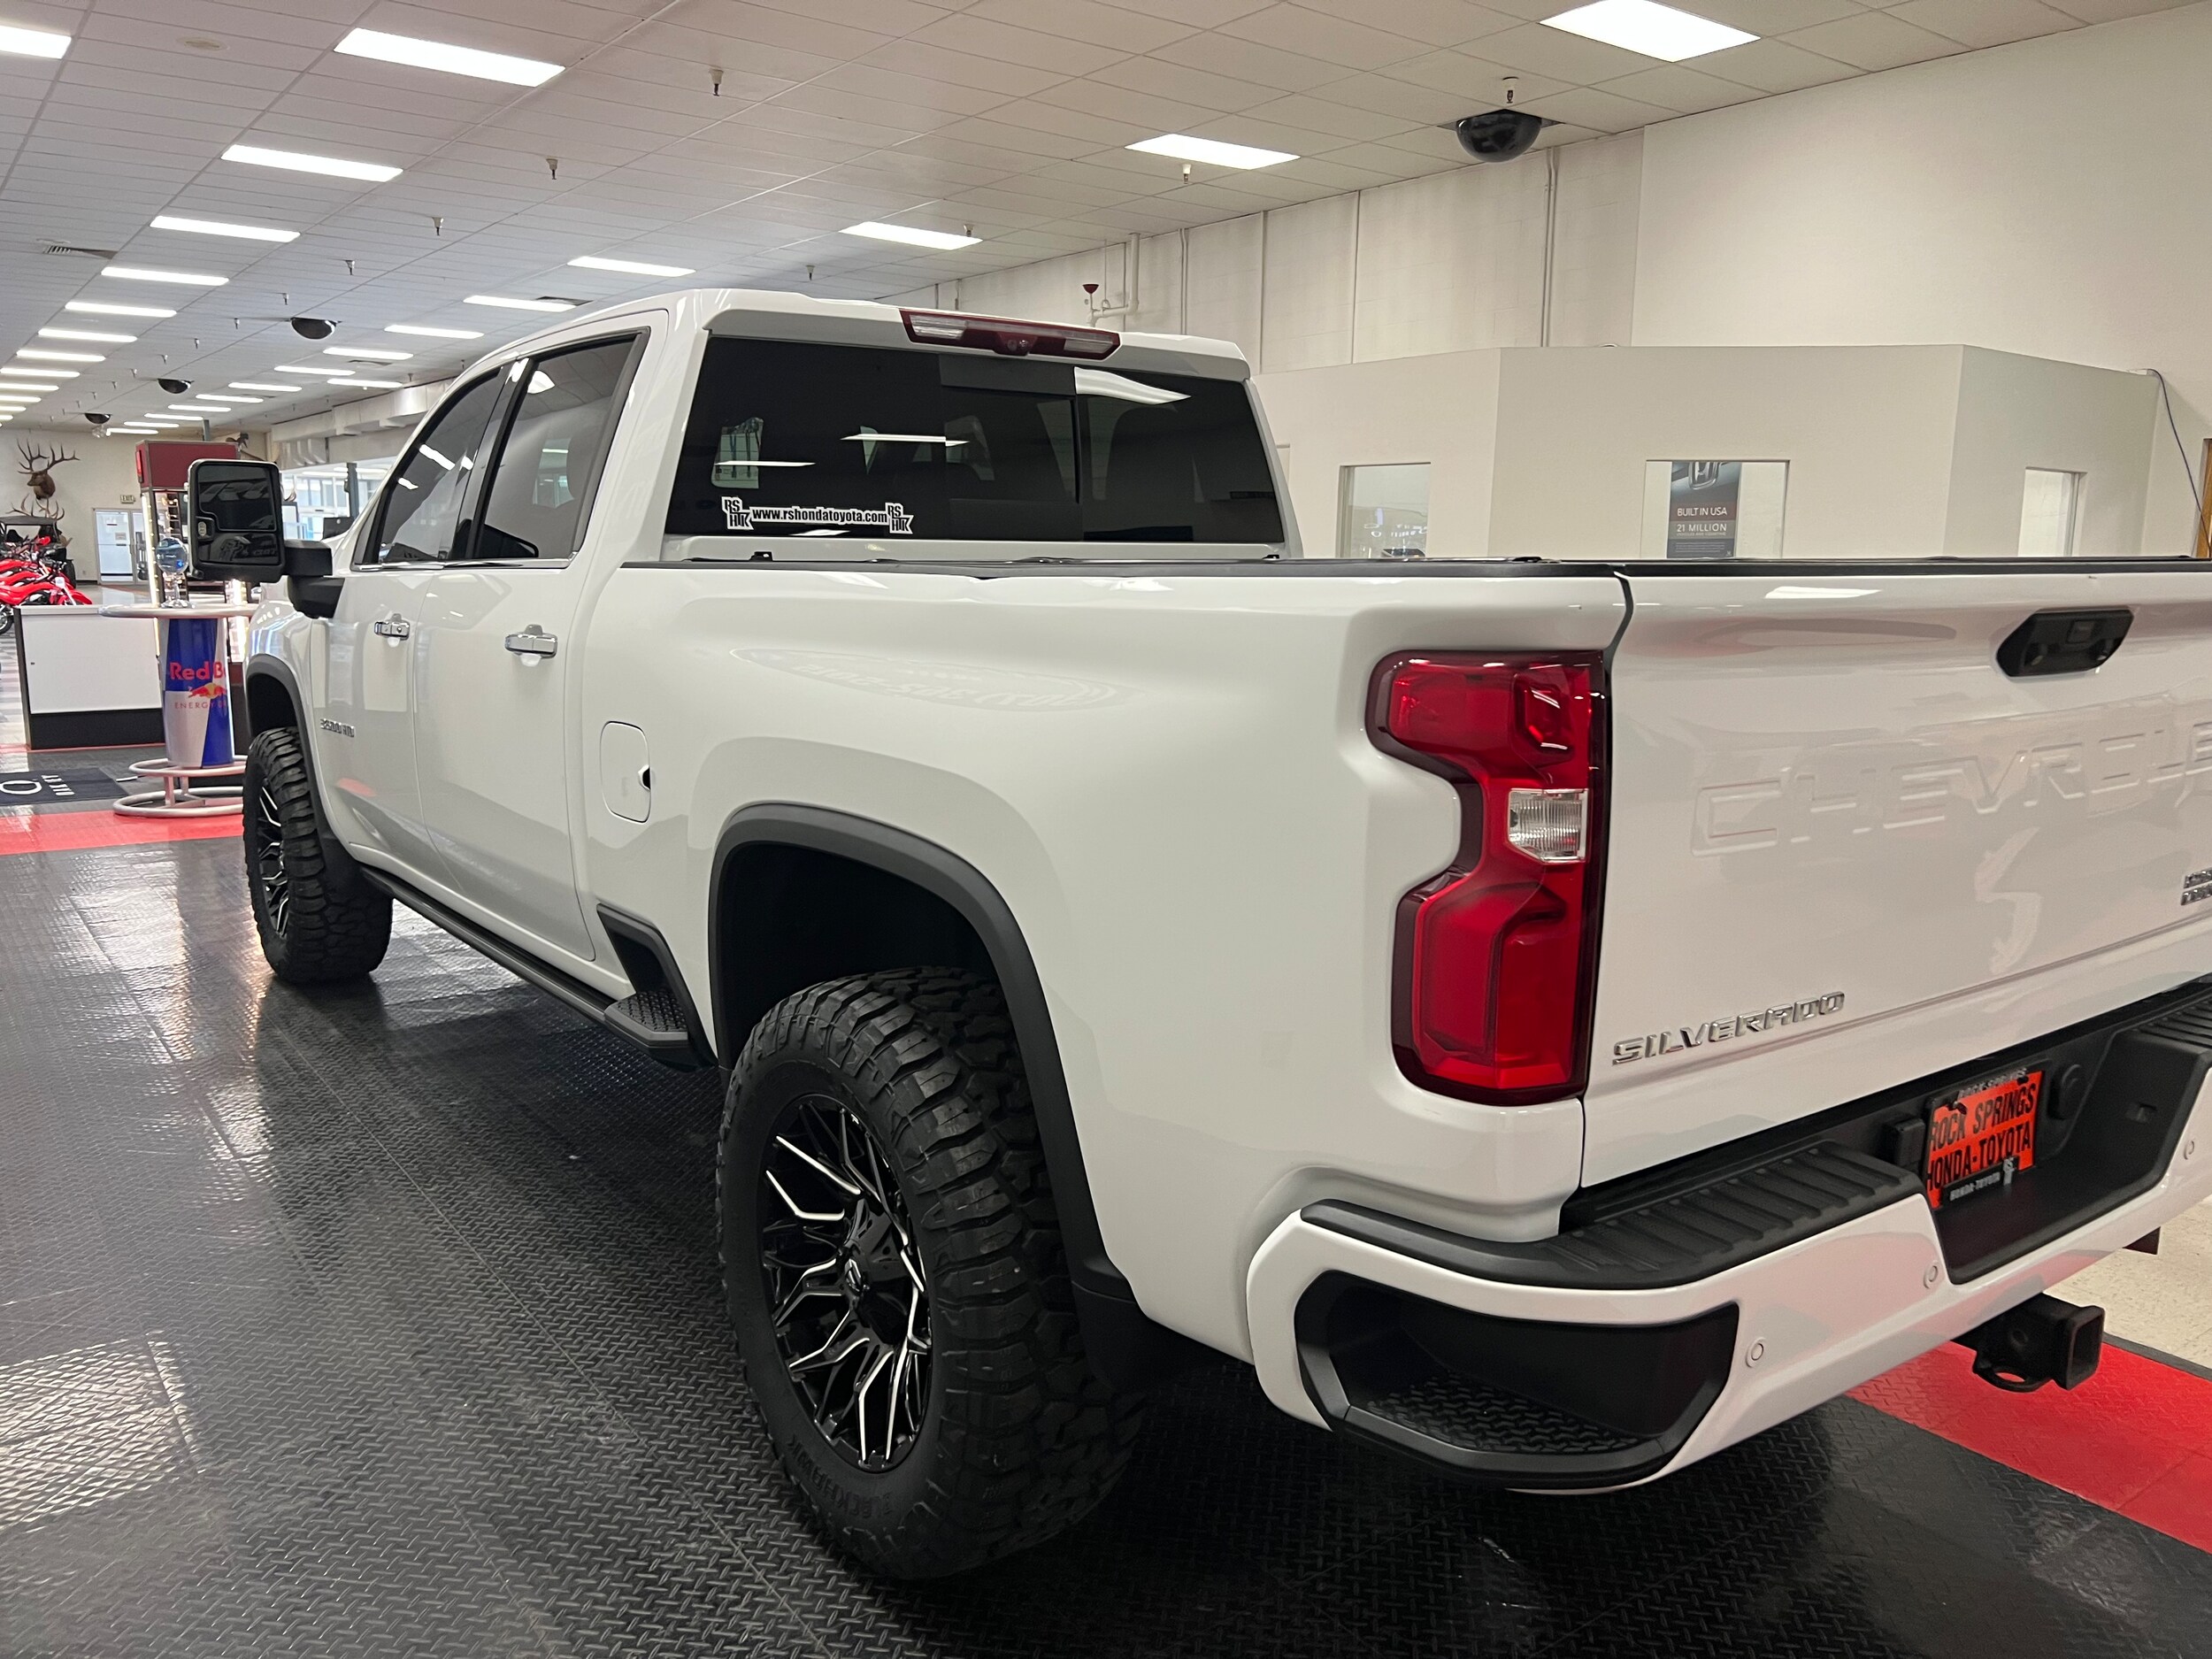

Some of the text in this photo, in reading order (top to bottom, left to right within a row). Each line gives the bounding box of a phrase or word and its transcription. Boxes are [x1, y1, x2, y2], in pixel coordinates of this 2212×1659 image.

[724, 499, 741, 512] RS
[887, 505, 902, 518] RS
[1677, 506, 1728, 517] BUILT IN USA
[752, 508, 887, 524] www.rshondatoyota.com
[1677, 523, 1727, 533] 21 MILLION
[170, 660, 211, 680] Red
[1612, 991, 1845, 1065] SILVERADO
[1930, 1082, 2036, 1152] ROCK SPRINGS
[1927, 1120, 2032, 1192] HONDA-TOYOTA
